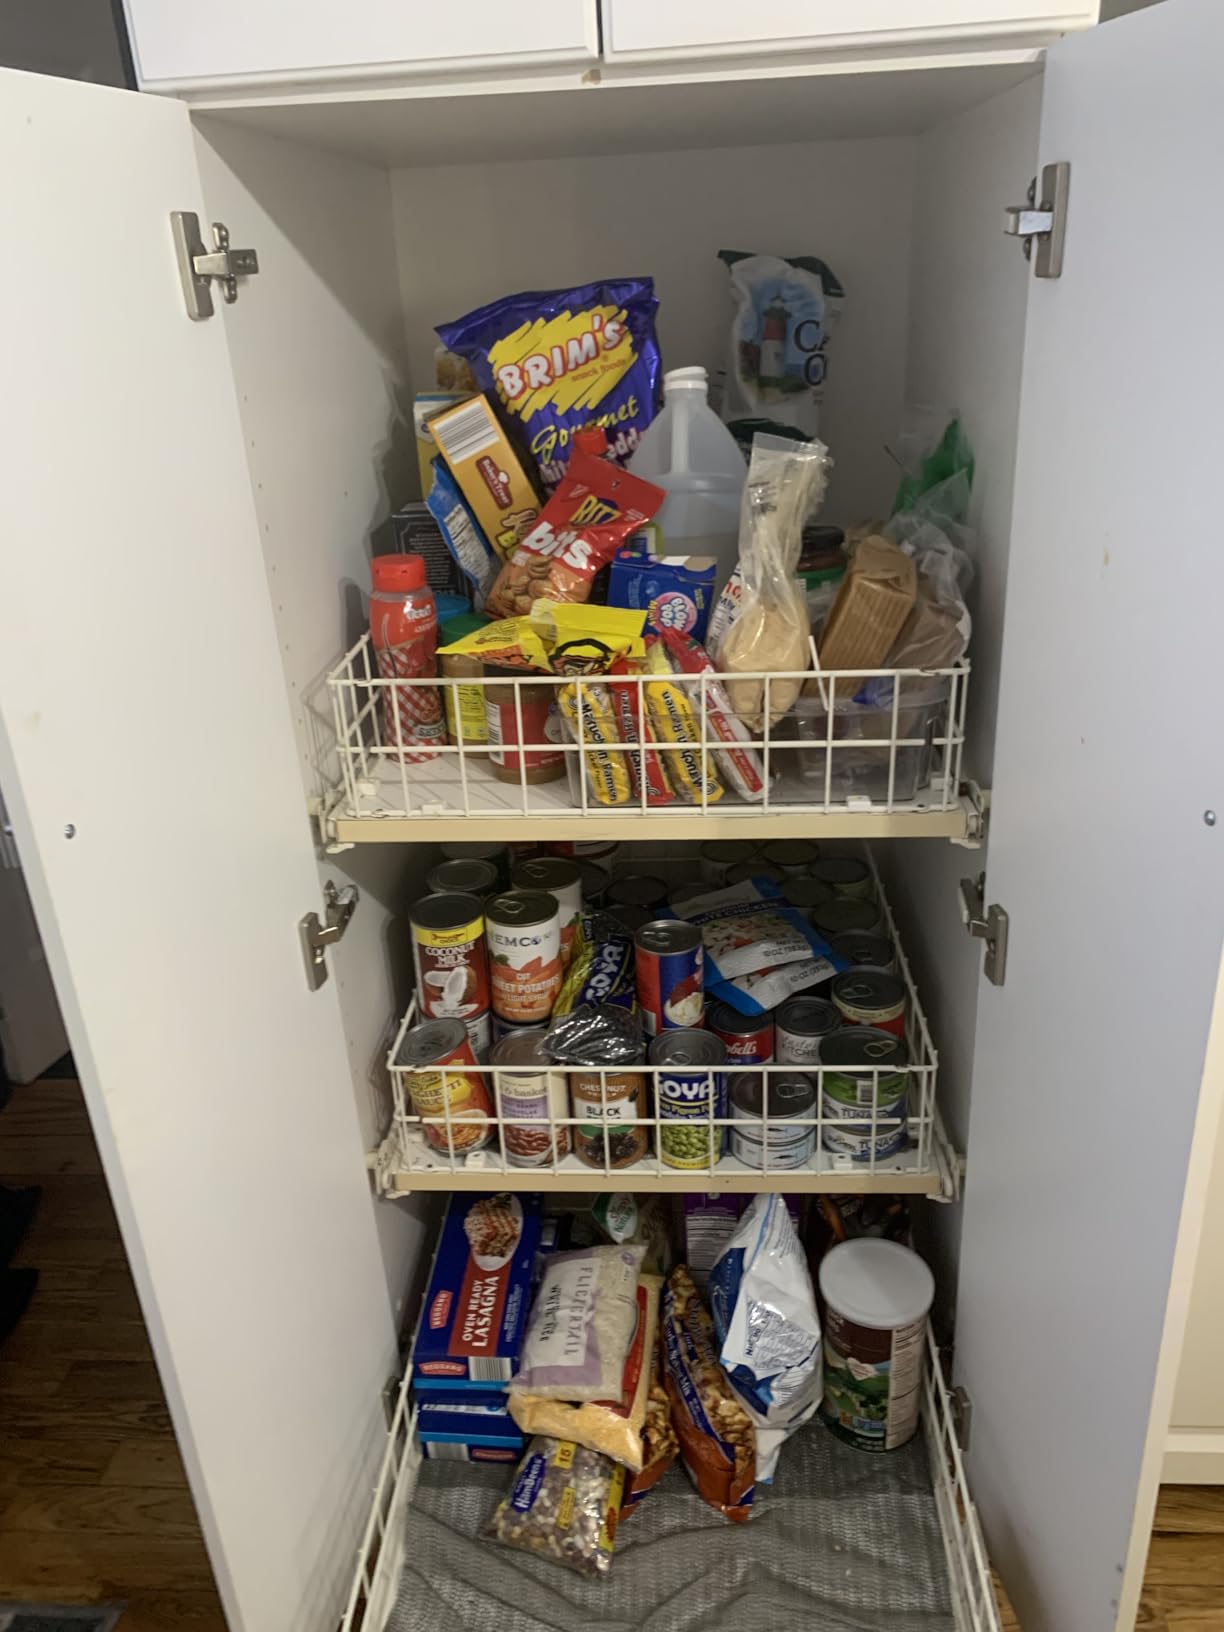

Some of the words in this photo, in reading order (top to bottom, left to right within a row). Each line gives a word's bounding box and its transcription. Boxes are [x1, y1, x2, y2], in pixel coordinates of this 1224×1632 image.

[498, 315, 624, 399] BRIM'S
[531, 396, 639, 464] Gomet
[522, 521, 593, 571] bits
[663, 691, 685, 733] Ramen
[581, 703, 608, 761] Maruchn
[602, 762, 618, 802] Ramen
[677, 735, 703, 789] Maruchn
[424, 941, 476, 957] COCONUT
[436, 954, 467, 966] MILK
[579, 1082, 627, 1092] CHESNUT
[659, 1081, 716, 1099] OYA
[468, 1279, 484, 1312] READY
[472, 1276, 500, 1347] LASAGNA
[462, 1314, 477, 1342] OVEN
